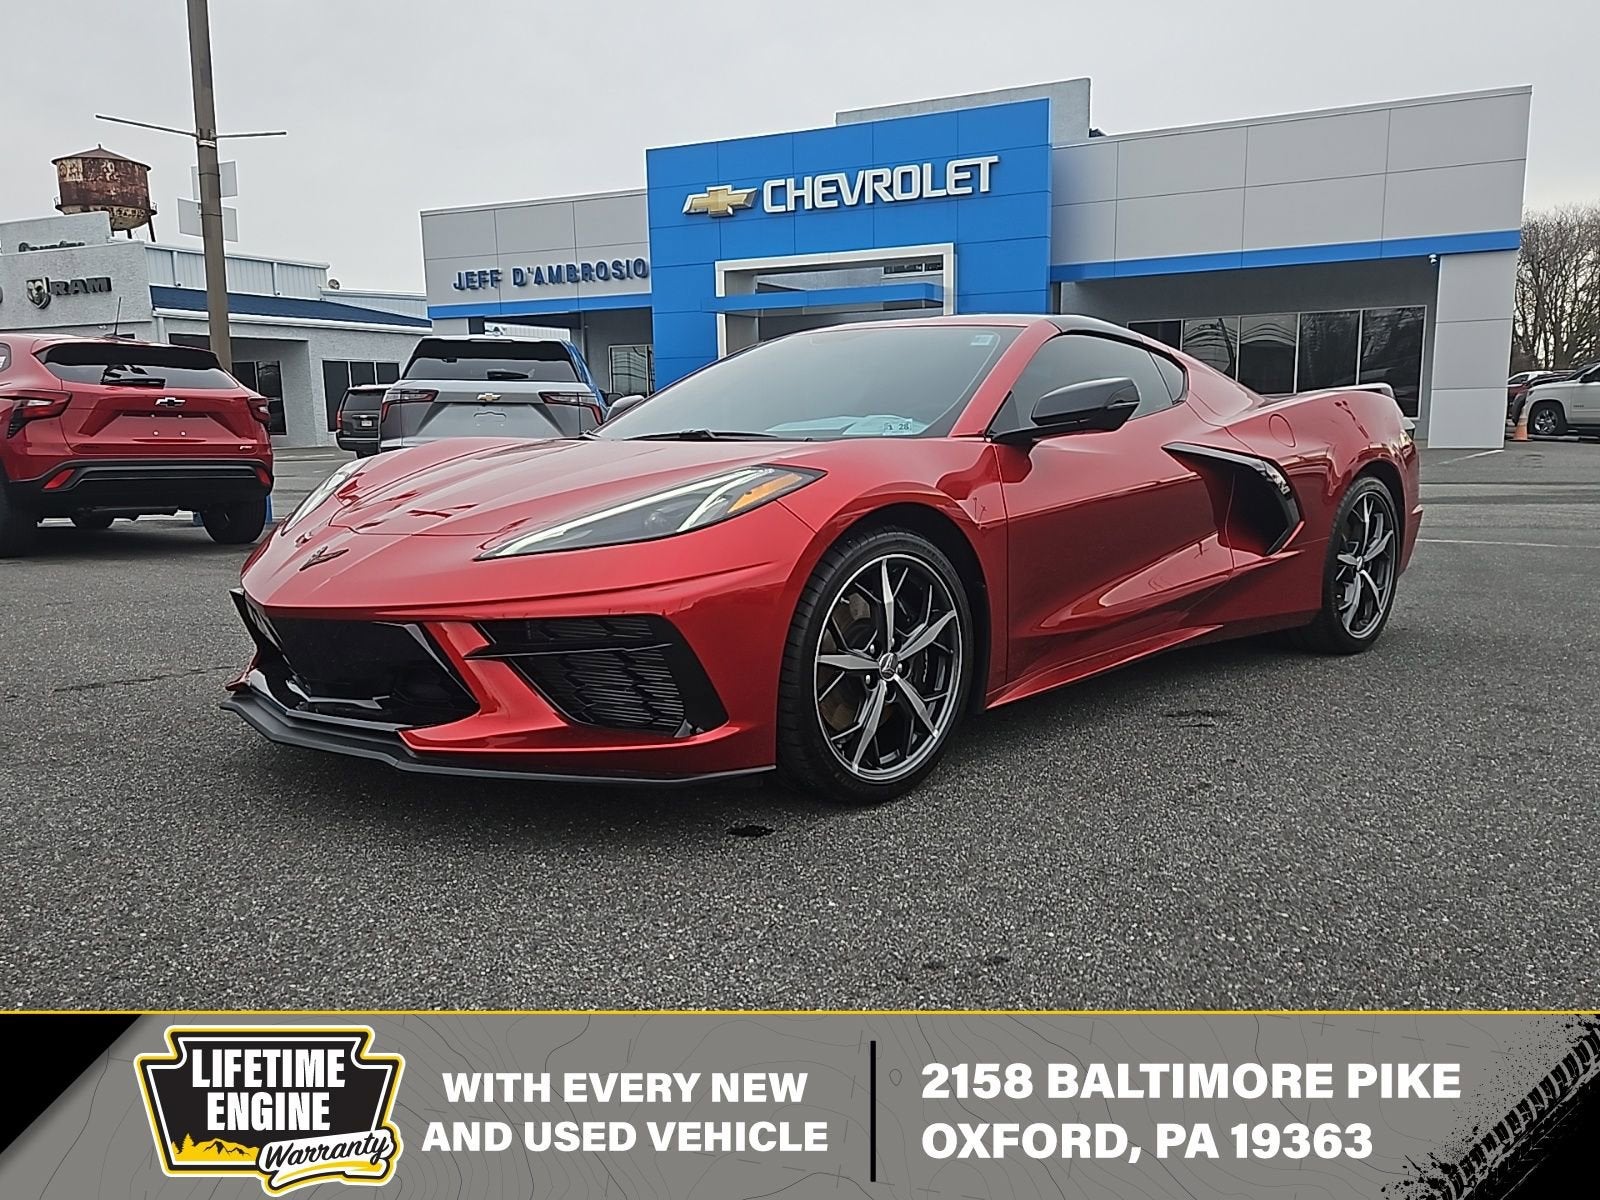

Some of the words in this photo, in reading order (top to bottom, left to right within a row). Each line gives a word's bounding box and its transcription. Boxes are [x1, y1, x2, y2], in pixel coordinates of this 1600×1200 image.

[763, 156, 999, 213] CHEVROLET
[50, 276, 112, 296] RAM
[453, 269, 501, 291] JEFF
[512, 257, 649, 287] D'AMBROSIO
